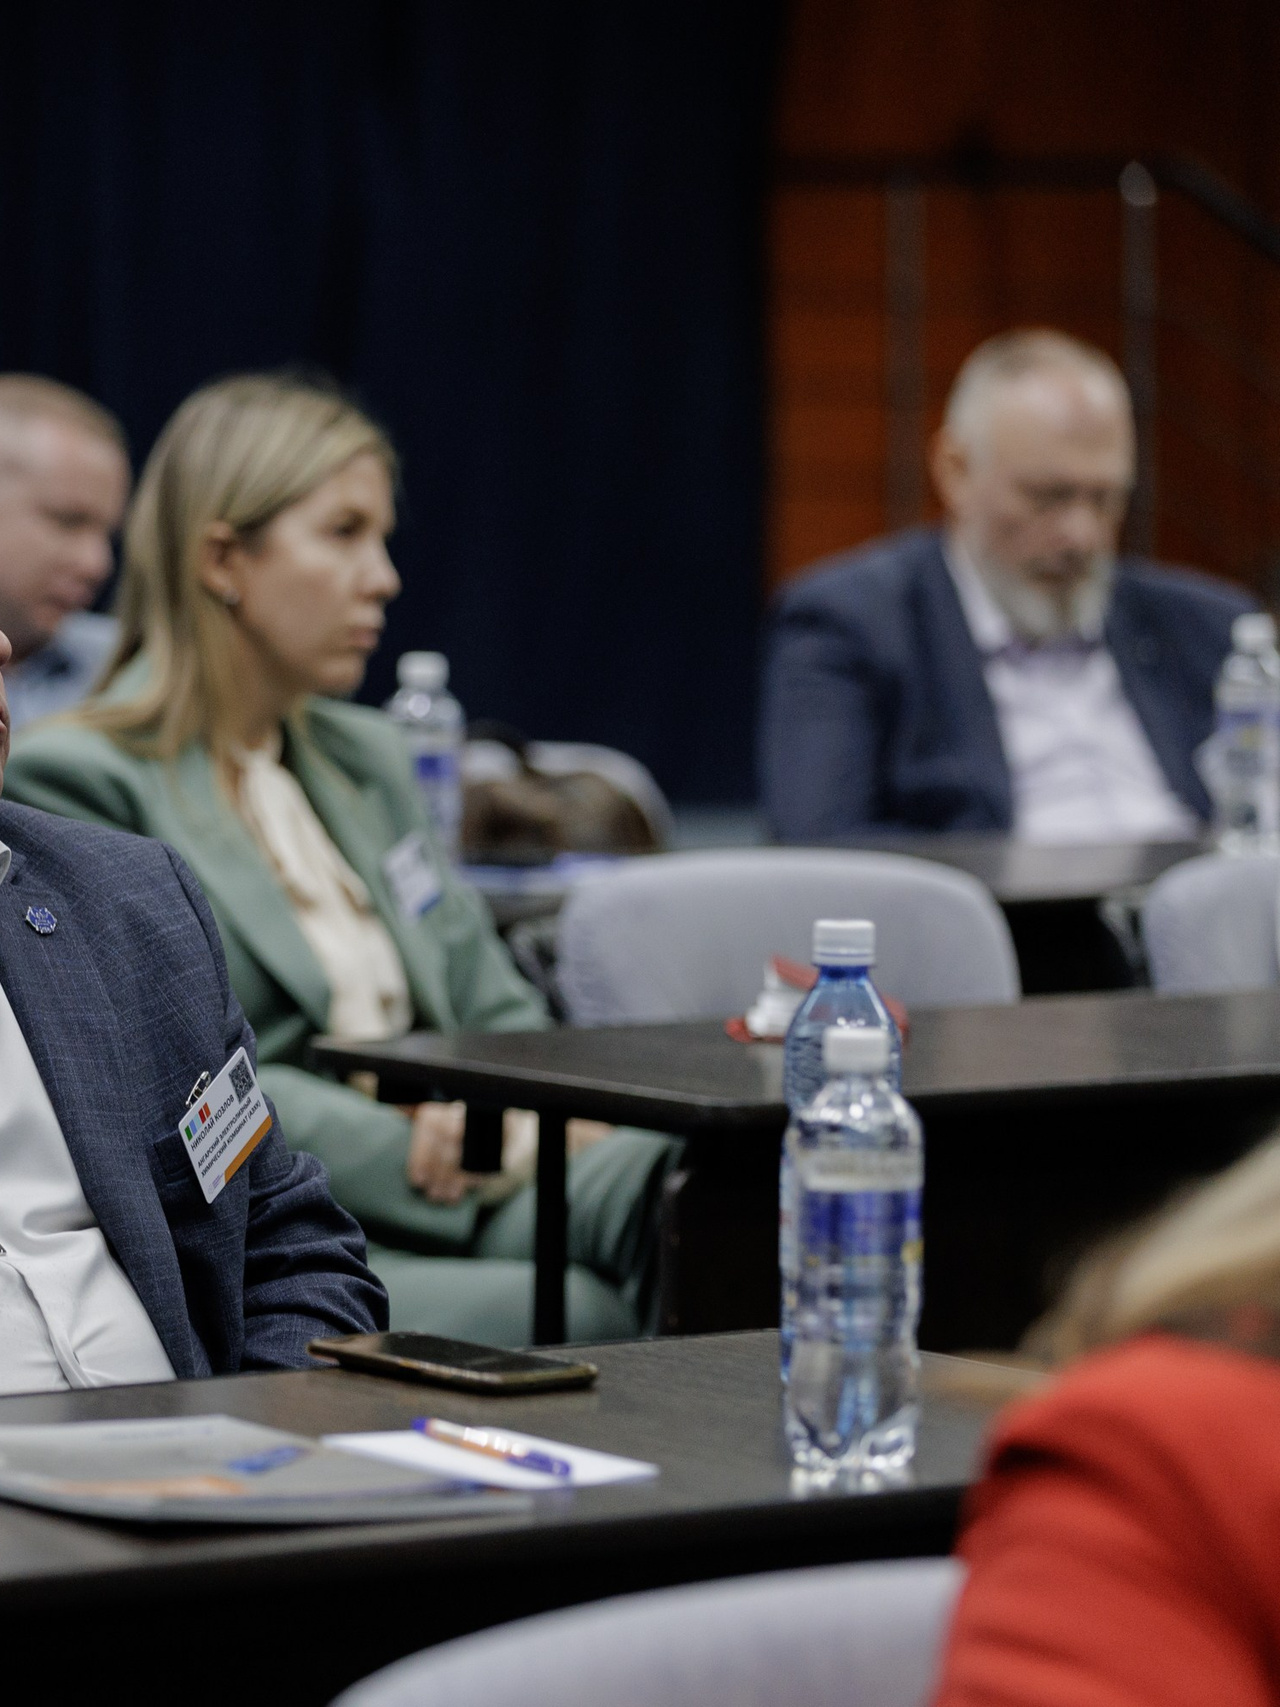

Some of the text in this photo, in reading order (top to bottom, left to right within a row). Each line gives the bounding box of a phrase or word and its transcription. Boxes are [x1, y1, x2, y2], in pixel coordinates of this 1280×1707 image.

[190, 1094, 235, 1152] НИКОЛАЙ КОЗЛОВ
[198, 1137, 220, 1168] АНГАРСКИЙ
[219, 1096, 252, 1141] ЭЛЕКТРОЛИЗНЫЙ
[201, 1141, 228, 1179] ХИМИЧЕСКИЙ
[226, 1115, 249, 1146] КОМБИНАТ
